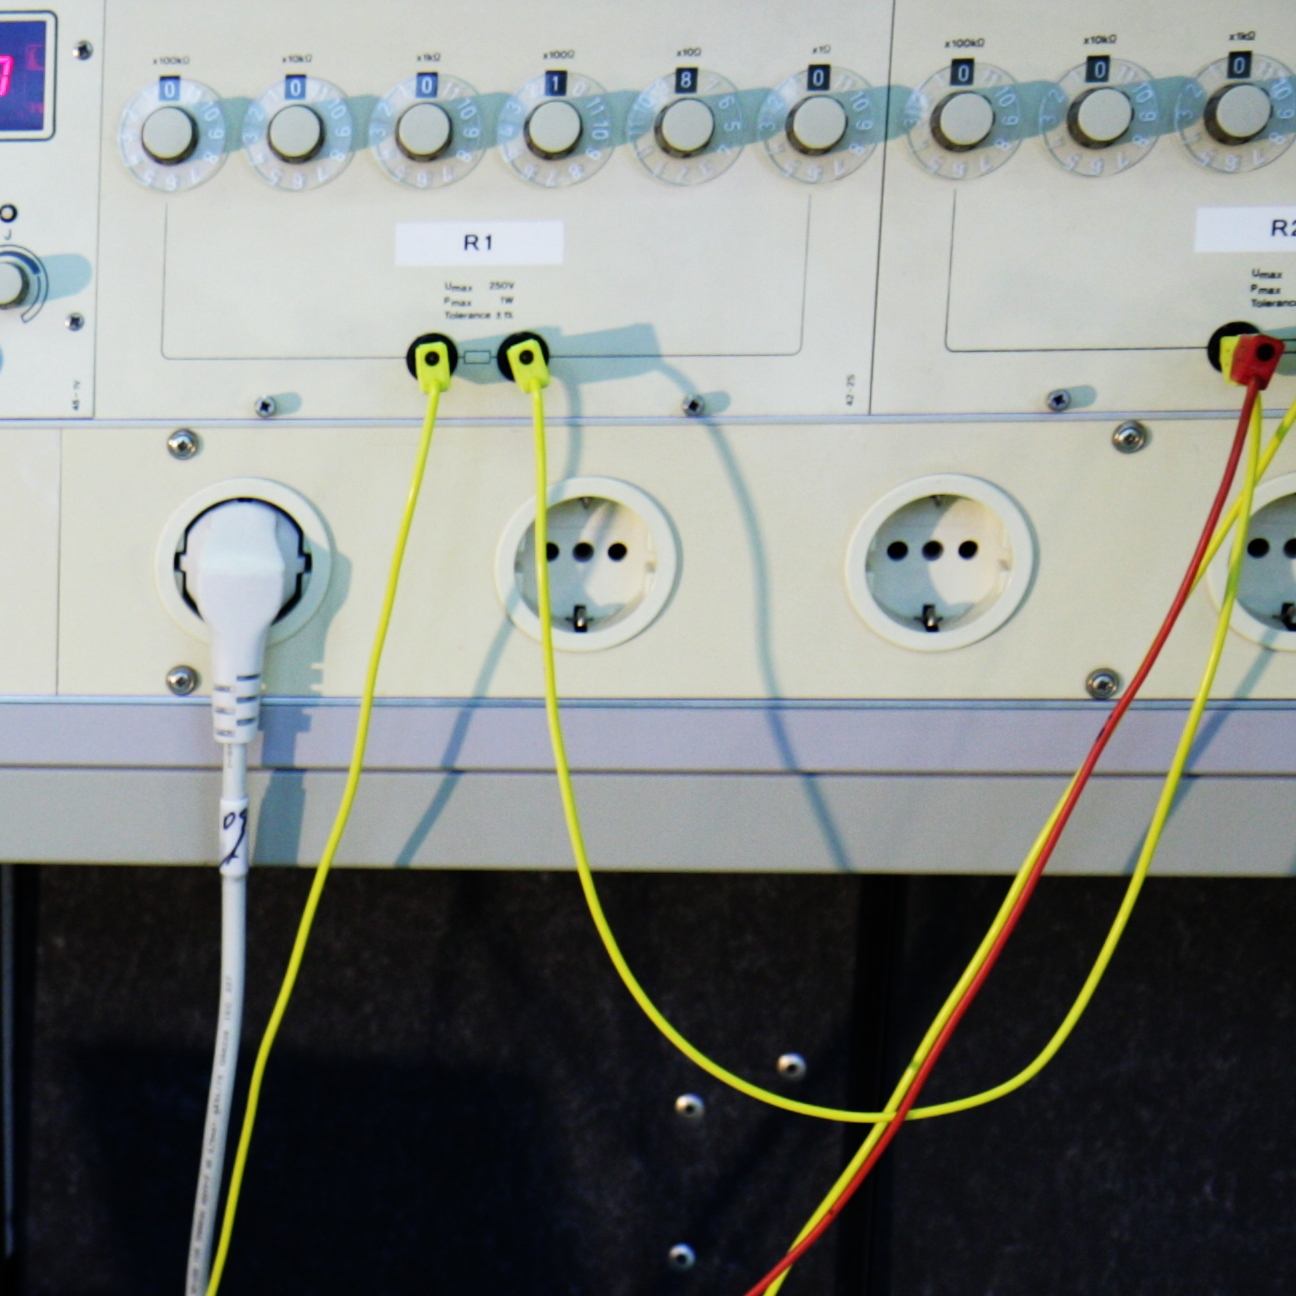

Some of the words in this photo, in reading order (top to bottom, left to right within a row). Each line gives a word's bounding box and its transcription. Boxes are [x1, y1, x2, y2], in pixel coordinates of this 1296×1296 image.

[958, 63, 971, 82] 0
[1094, 61, 1107, 80] 0
[1232, 57, 1246, 76] 0
[420, 76, 434, 94] 0
[551, 74, 560, 93] 1
[680, 70, 694, 89] 8
[812, 69, 826, 87] 0
[164, 81, 176, 99] 0
[289, 79, 302, 97] 0
[463, 233, 493, 253] R1
